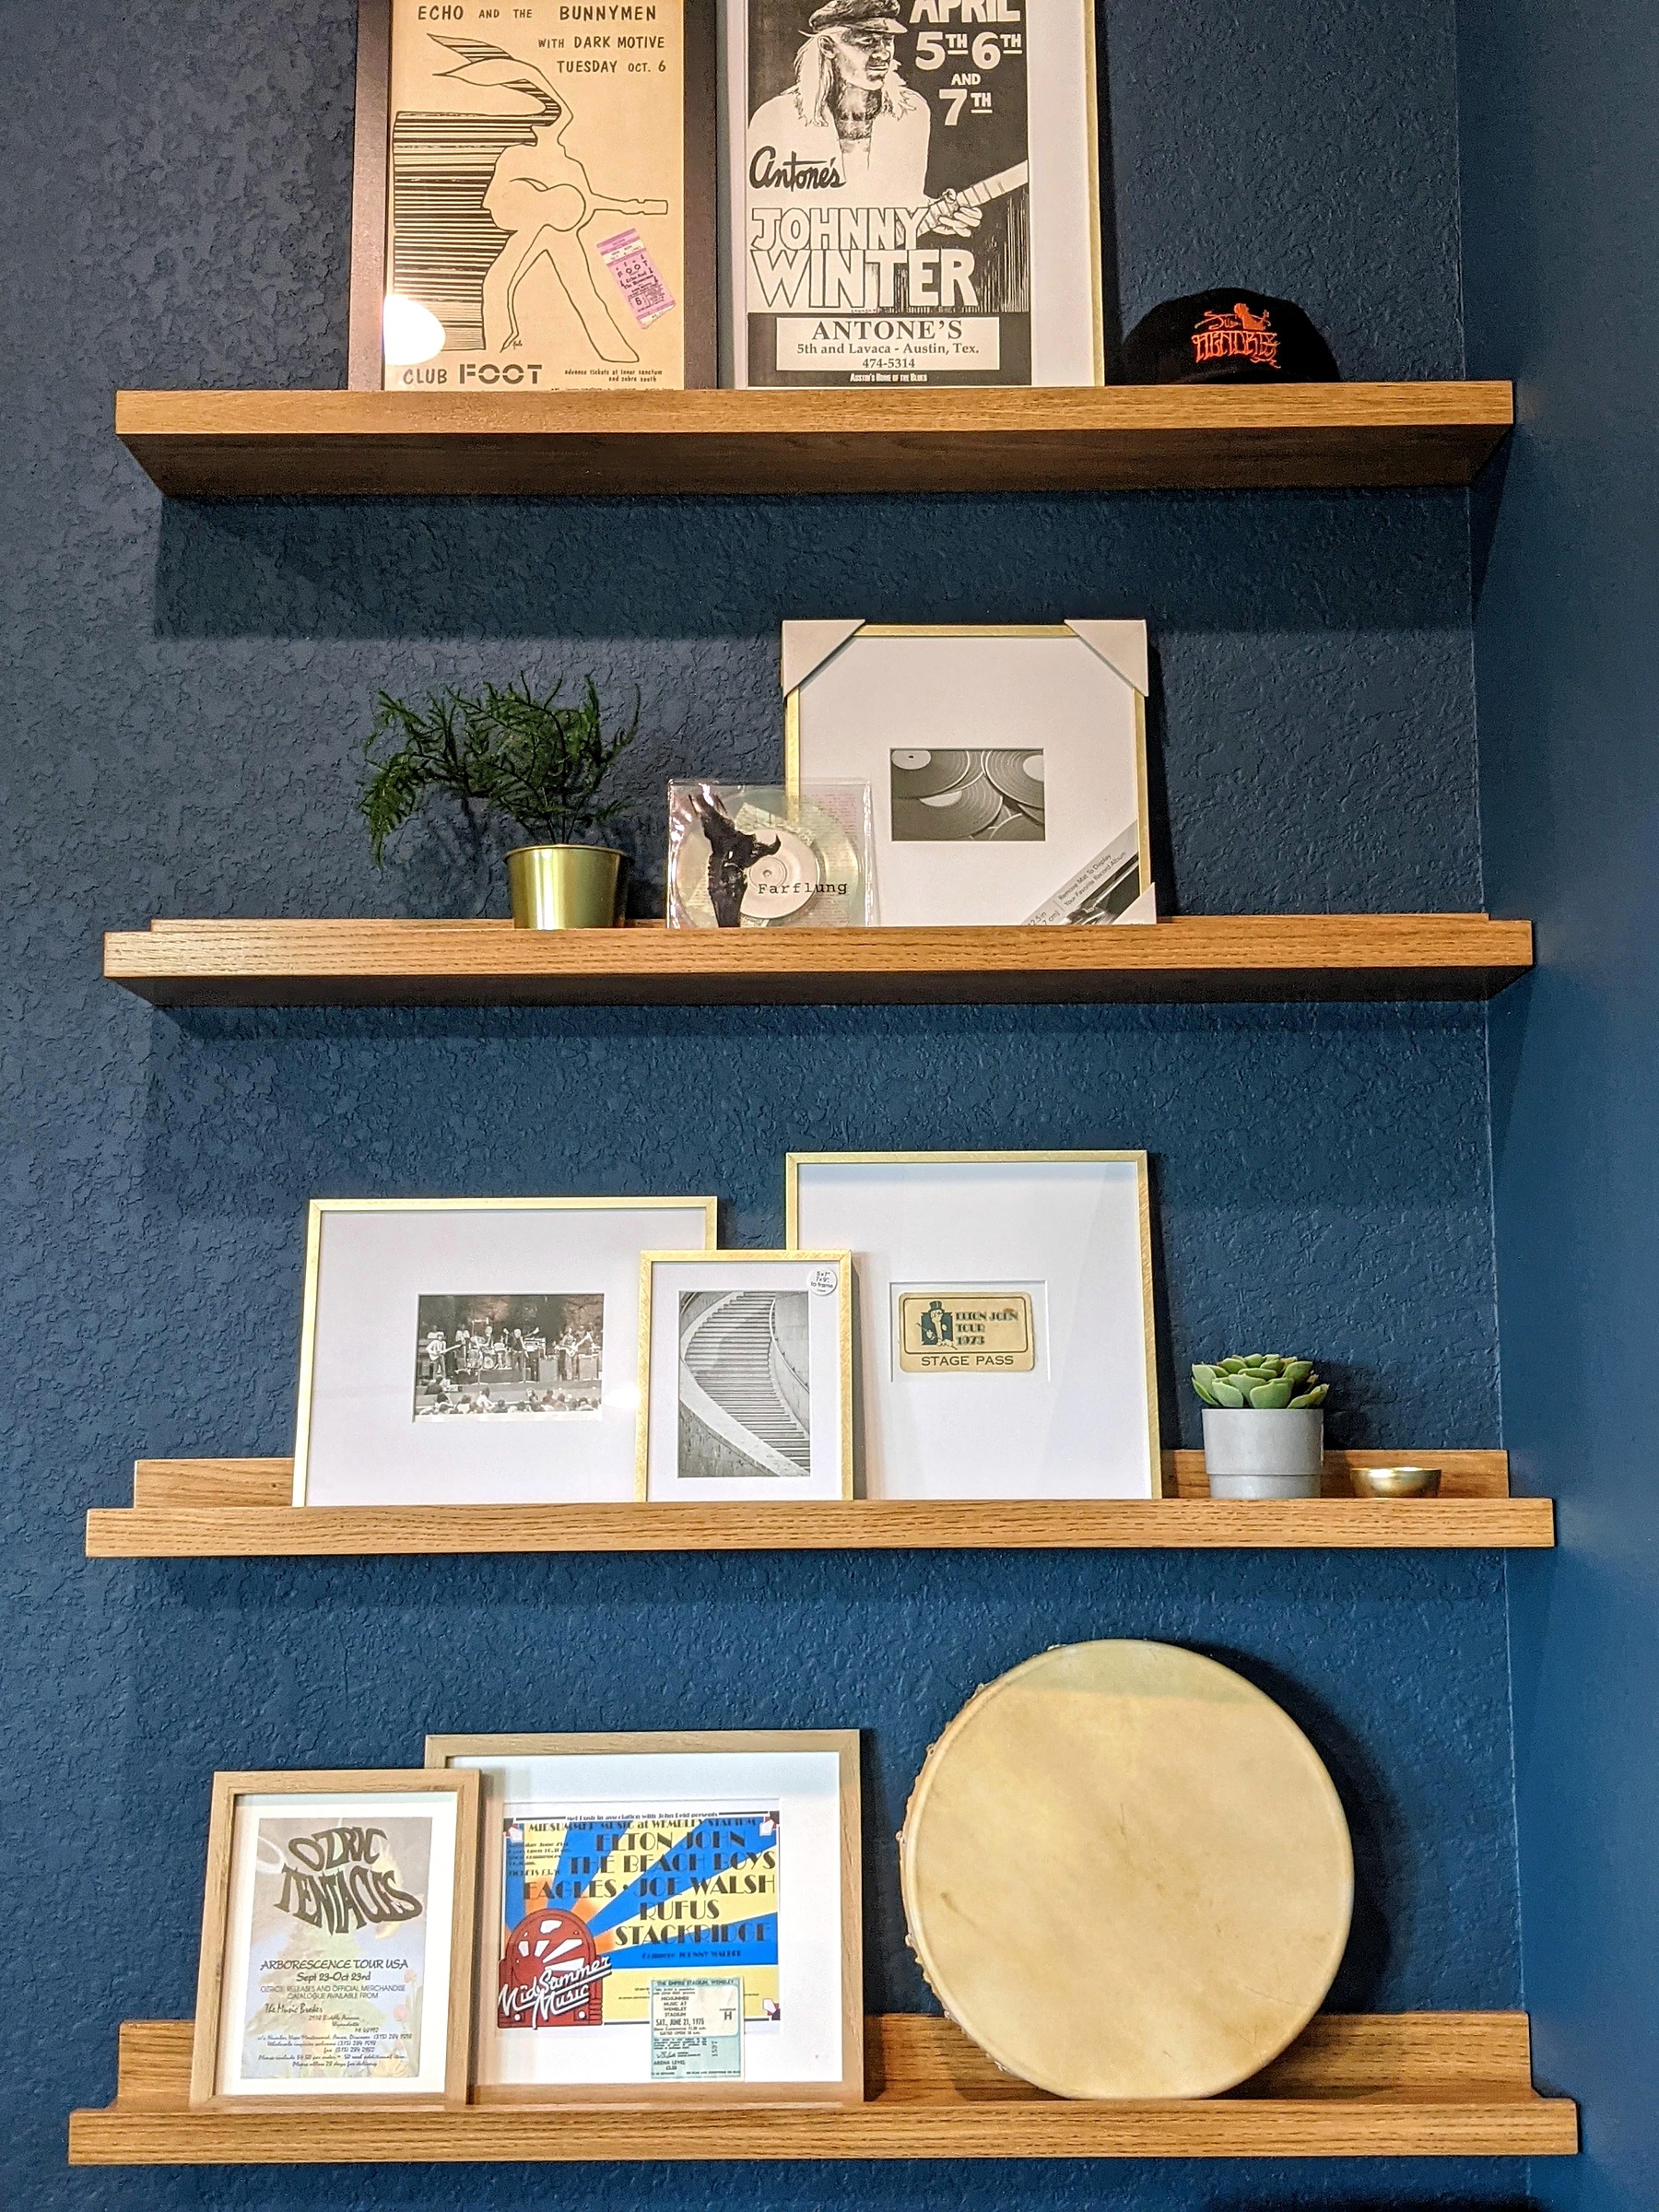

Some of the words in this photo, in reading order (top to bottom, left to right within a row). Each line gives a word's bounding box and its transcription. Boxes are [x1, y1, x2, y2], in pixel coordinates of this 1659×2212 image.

[418, 6, 464, 21] ECHO
[478, 9, 500, 18] AND
[513, 8, 533, 18] THE
[559, 6, 657, 22] BUNNYMEN
[910, 0, 1020, 23] APRIL
[538, 38, 565, 49] WITH
[574, 36, 611, 49] DARK
[618, 36, 665, 49] MOTIVE
[915, 31, 968, 70] 5TH
[971, 31, 1022, 70] 6TH
[557, 60, 618, 74] TUESDAY
[628, 62, 652, 73] OCT.
[658, 61, 666, 73] 6
[951, 73, 982, 86] AND
[939, 88, 993, 127] 7TH
[751, 207, 929, 252] JOHNNY
[751, 249, 979, 309] WINTER
[812, 320, 962, 340] ANTONE'S
[797, 343, 818, 354] 5th
[821, 343, 844, 354] and
[849, 343, 891, 354] Lavaca
[902, 343, 949, 356] Austin,
[953, 343, 980, 354] Tex.
[863, 358, 915, 369] 474-5314
[403, 368, 447, 384] CLUB
[459, 363, 543, 384] FOOT
[758, 882, 847, 896] Farflung
[955, 1324, 985, 1333] TOUR
[956, 1335, 985, 1346] 1973
[922, 1356, 970, 1366] STAGE
[976, 1355, 1014, 1366] PASS
[637, 1820, 648, 1829] at
[652, 1818, 702, 1829] WEMBLEY
[595, 1831, 673, 1853] ELTON
[685, 1830, 747, 1850] JOHN
[568, 1855, 615, 1875] THE
[623, 1853, 705, 1873] BEACH
[713, 1851, 776, 1871] BOYS
[524, 1879, 618, 1900] EAGLES
[633, 1877, 683, 1897] JOE
[690, 1874, 775, 1896] WALSH
[640, 1900, 720, 1921] RUFUS
[615, 1922, 771, 1947] STACKRIDGE
[260, 1959, 351, 1971] ARBORESCENCE
[353, 1959, 383, 1970] TOUR
[386, 1959, 408, 1970] USA
[296, 1971, 317, 1983] Sept
[319, 1971, 349, 1982] 23-Oct
[351, 1971, 371, 1982] 23rd
[265, 2003, 276, 2013] The
[532, 1984, 590, 2030] Music
[670, 2018, 682, 2026] JUNE
[724, 2011, 732, 2020] H
